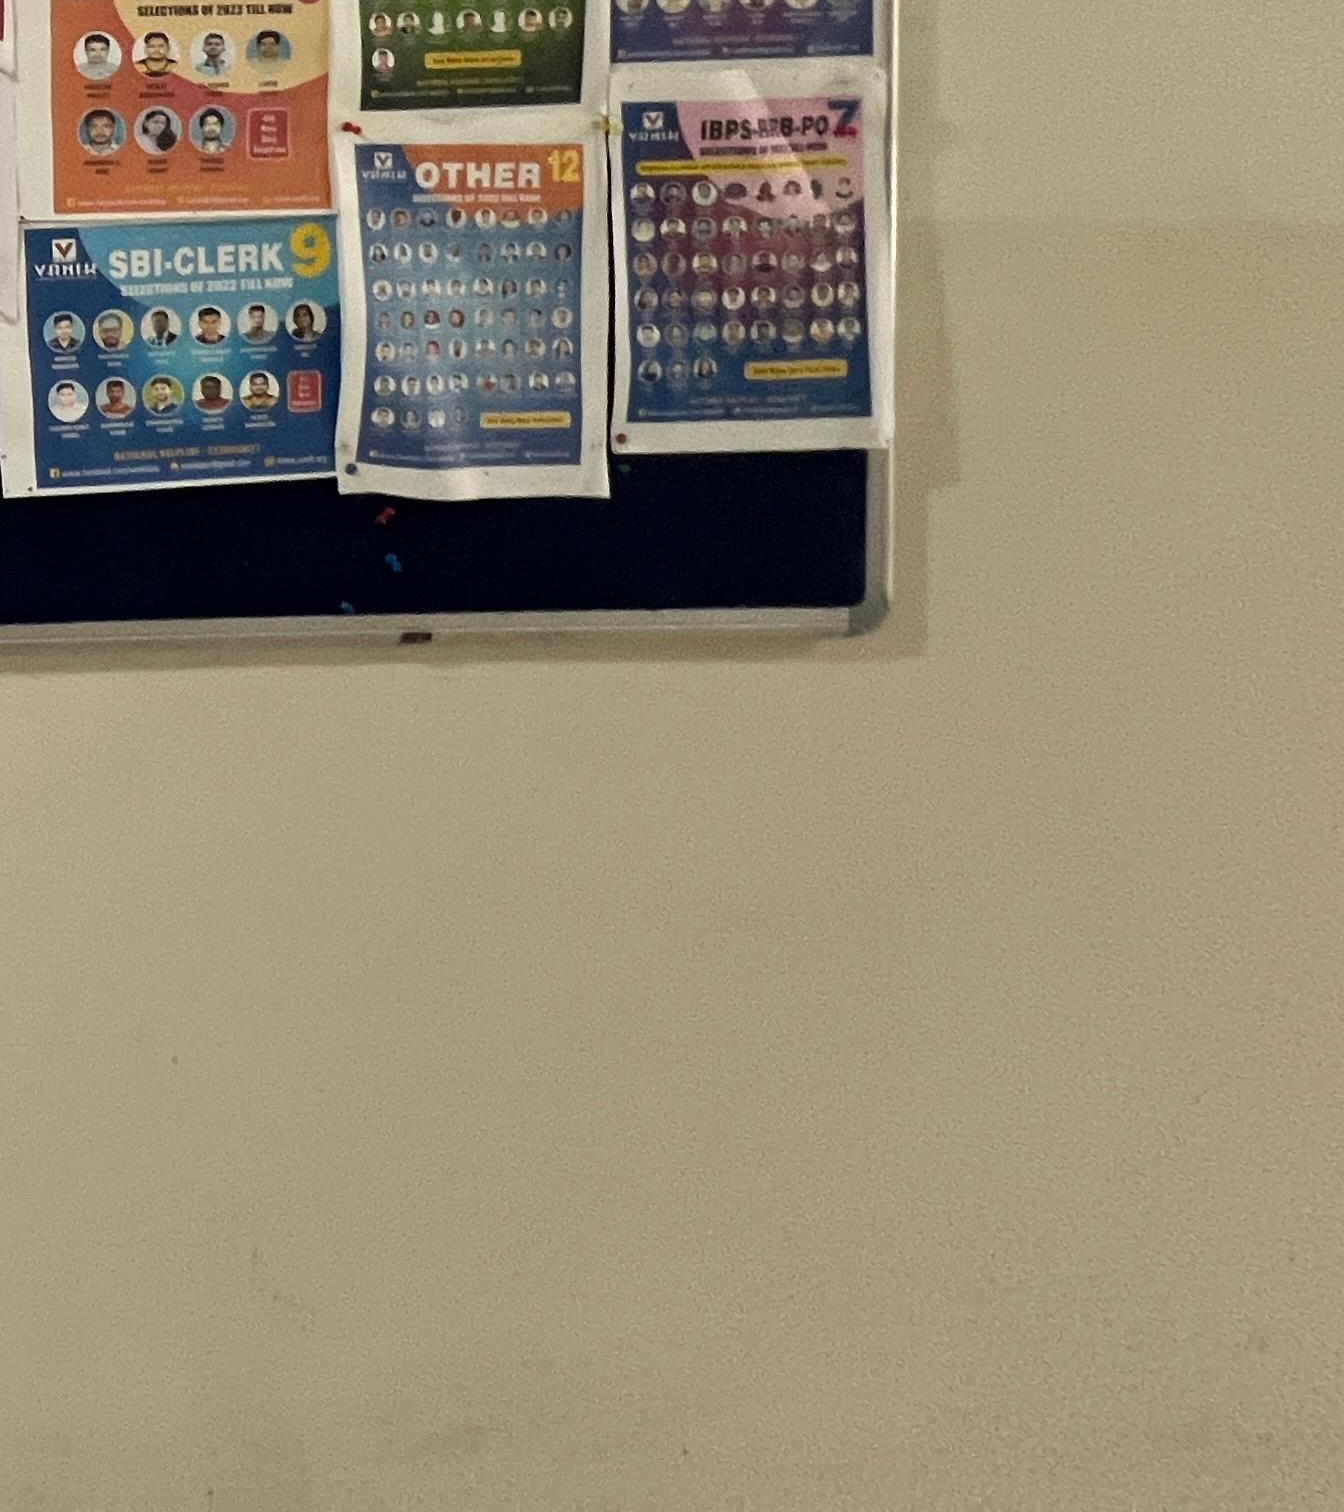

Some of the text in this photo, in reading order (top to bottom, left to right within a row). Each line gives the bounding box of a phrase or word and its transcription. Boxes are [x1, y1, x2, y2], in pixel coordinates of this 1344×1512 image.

[415, 149, 581, 189] OTHER 12
[108, 222, 331, 279] SBI-CLERK 9
